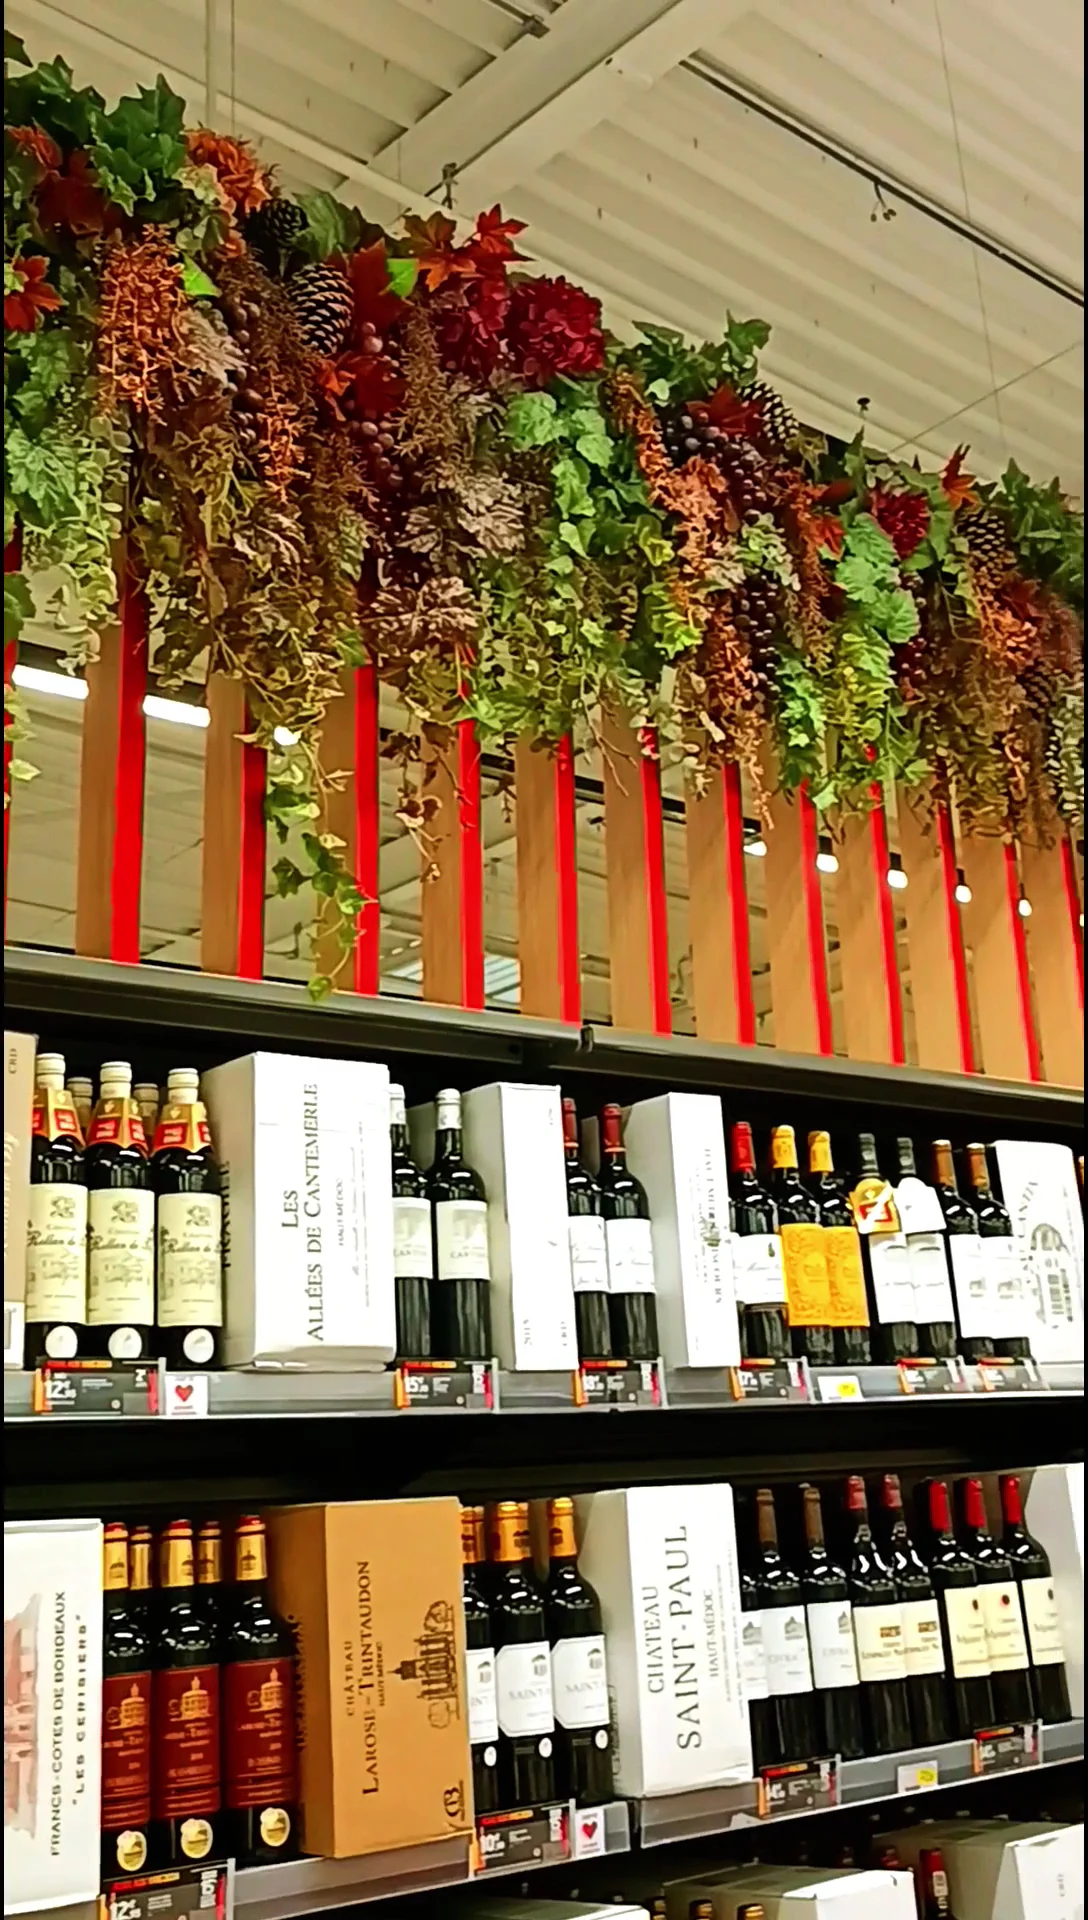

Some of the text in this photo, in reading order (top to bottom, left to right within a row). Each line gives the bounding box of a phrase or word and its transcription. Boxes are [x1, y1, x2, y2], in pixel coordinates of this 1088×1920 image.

[281, 1189, 299, 1230] LES
[303, 1083, 324, 1342] ALLÉES DE CANTEMERLE
[53, 1590, 66, 1683] BORDEAUX
[52, 1686, 65, 1711] DE
